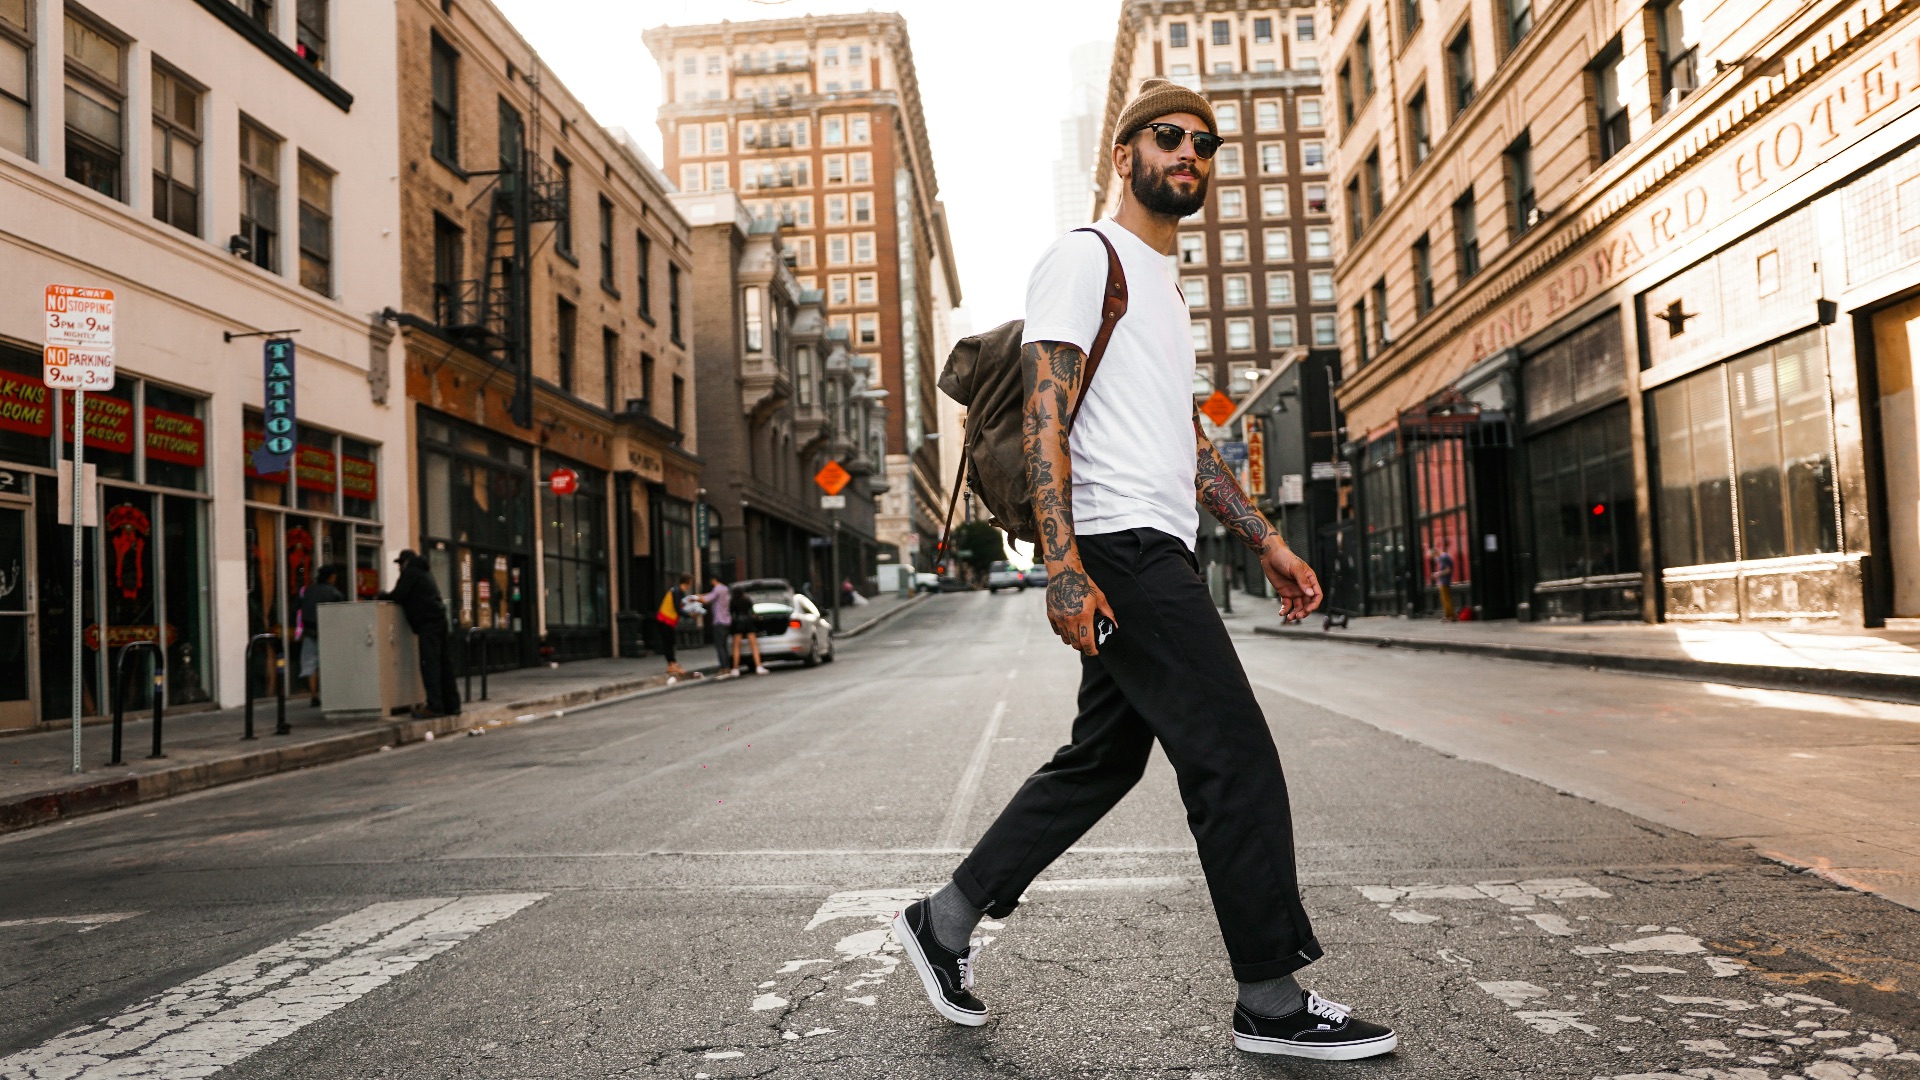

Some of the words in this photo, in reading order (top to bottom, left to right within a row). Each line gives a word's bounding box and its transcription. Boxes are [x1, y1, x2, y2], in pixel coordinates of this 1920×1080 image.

[896, 178, 912, 281] HOTEL
[1472, 302, 1533, 363] KING
[1544, 185, 1708, 319] EDWARD
[47, 294, 66, 311] NO
[68, 300, 112, 315] STOPPING
[63, 331, 96, 339] NIGHTLY
[47, 348, 67, 365] NO
[69, 353, 112, 368] PARKING
[902, 299, 919, 444] ROSSLYN
[0, 379, 46, 405] K-INS
[267, 342, 294, 454] TATTOO
[0, 401, 46, 425] COME
